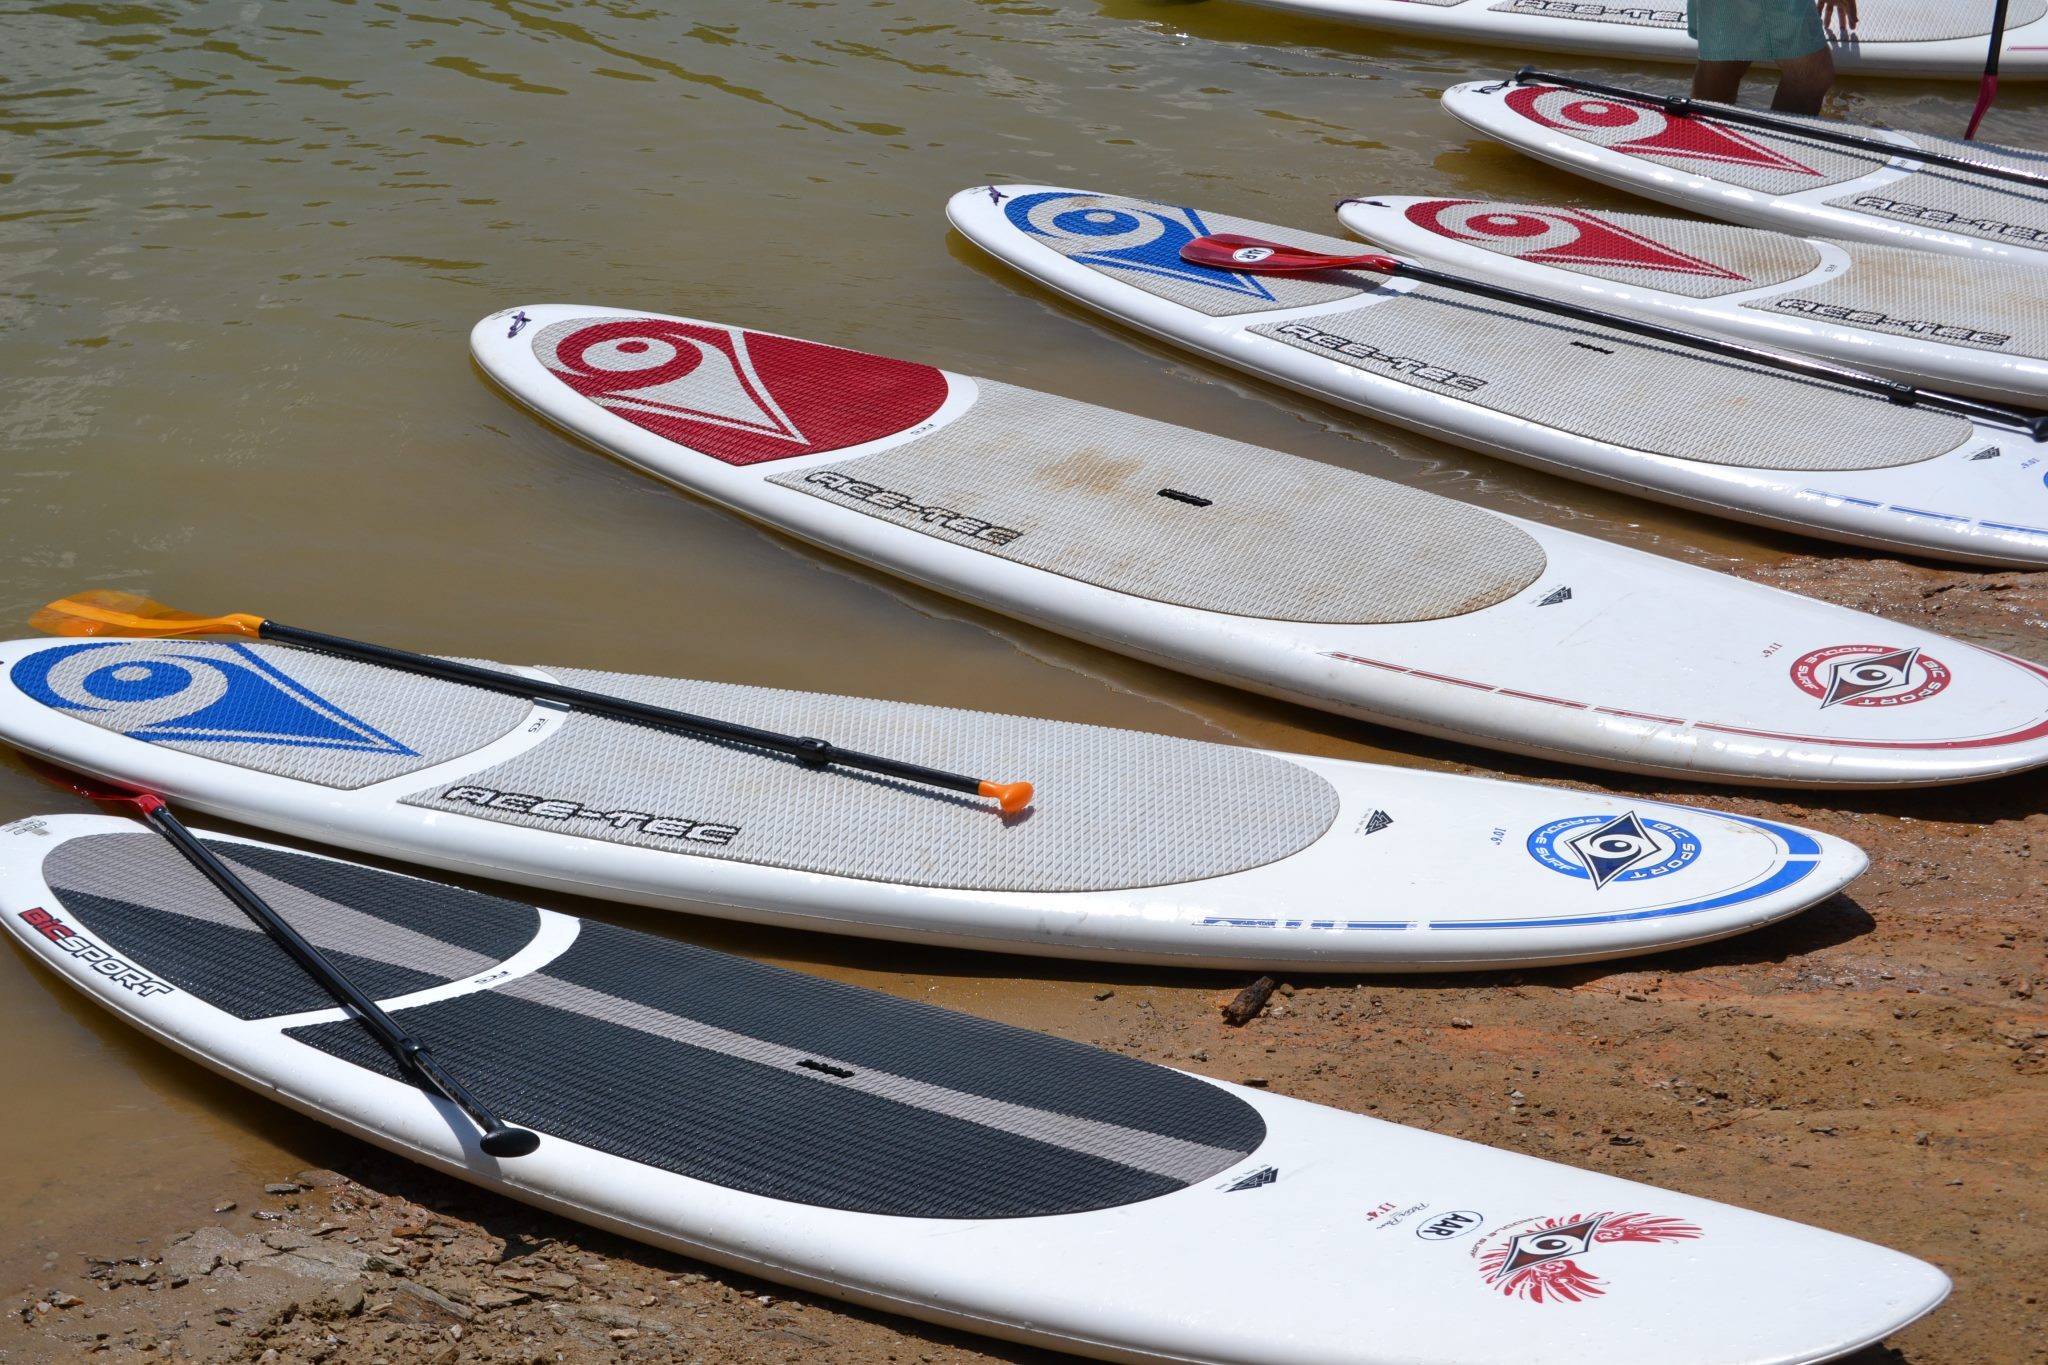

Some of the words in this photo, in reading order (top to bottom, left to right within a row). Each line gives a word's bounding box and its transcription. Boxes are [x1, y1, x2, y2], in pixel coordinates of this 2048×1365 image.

[1514, 0, 1690, 22] ACE-TE
[805, 471, 1023, 546] ACE-TEC
[1805, 646, 1883, 664] PADDLE
[1797, 664, 1820, 691] SURF
[1857, 680, 1942, 706] SPORT
[442, 786, 741, 845] ACE-TEC
[1535, 816, 1602, 844] PADDLE
[1535, 846, 1578, 872] SURF
[1630, 842, 1697, 880] SPORT
[1422, 1213, 1475, 1238] AAR
